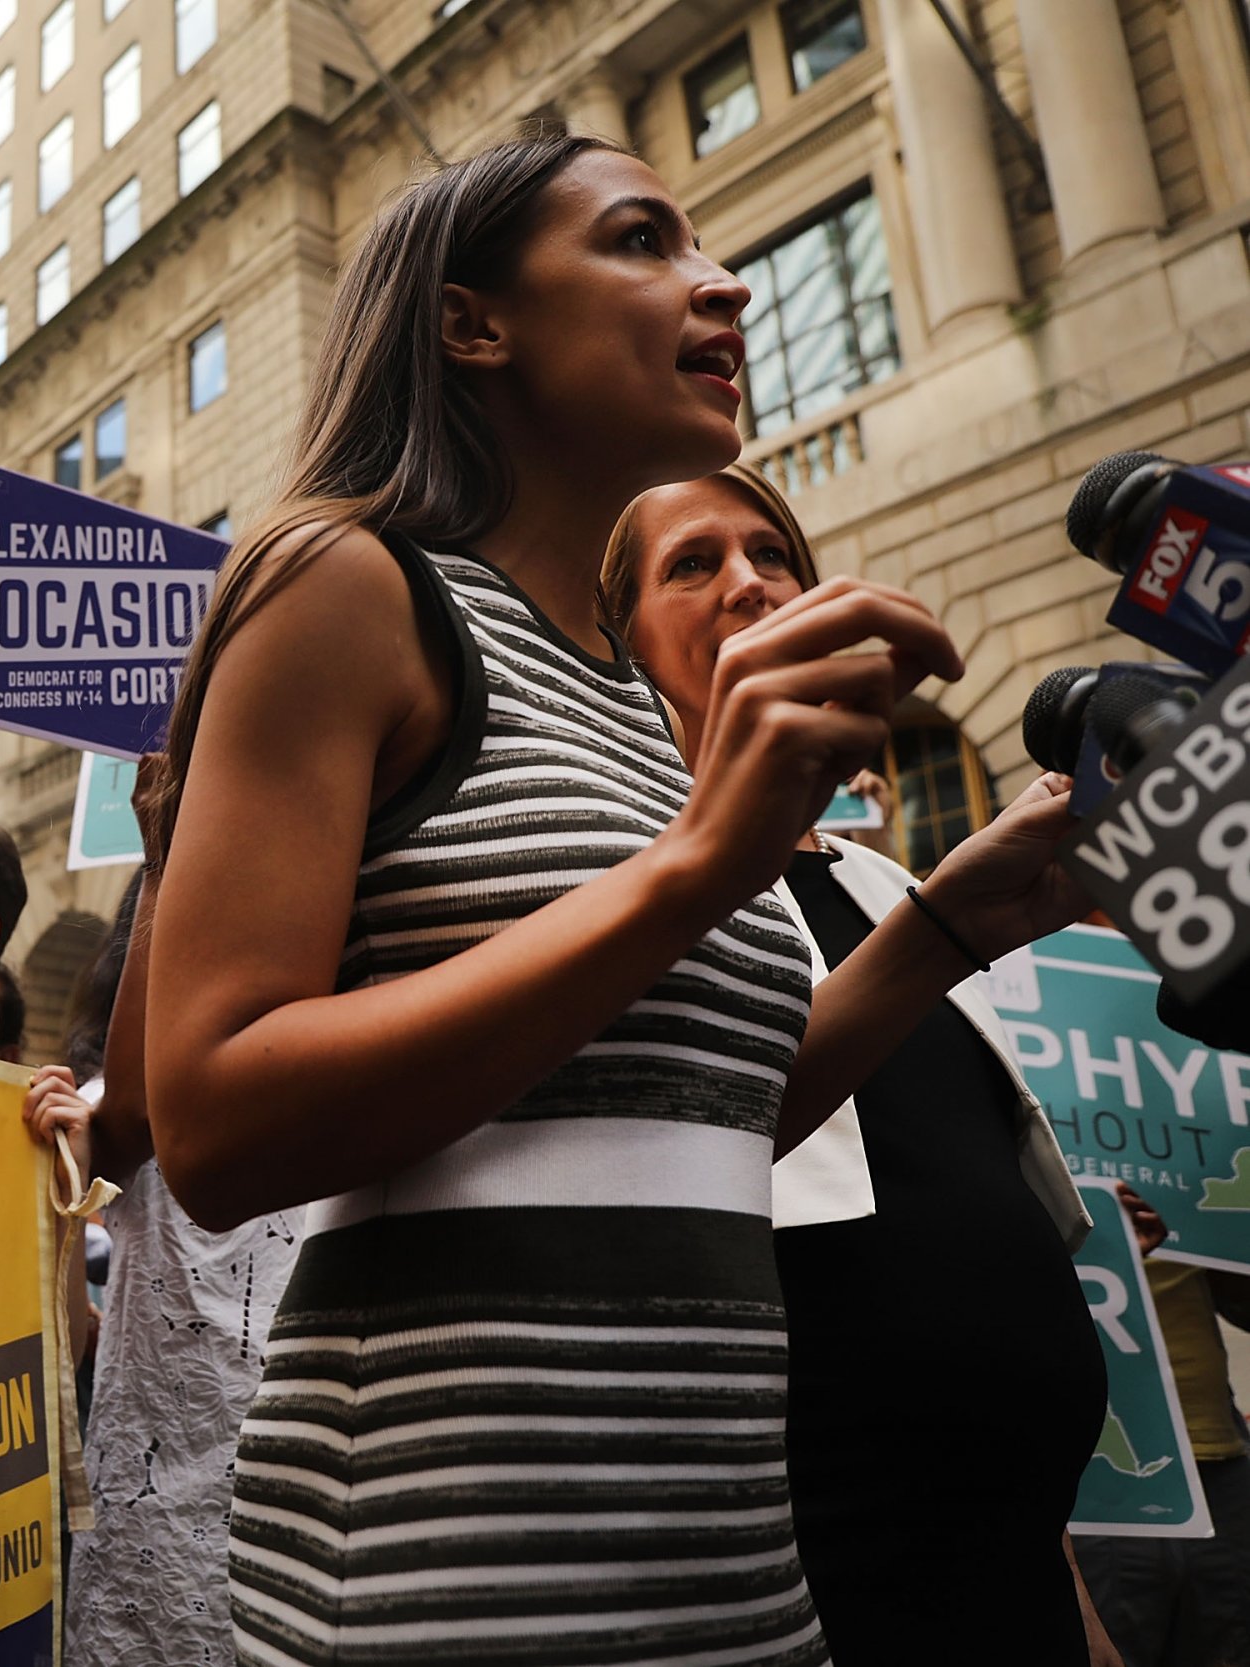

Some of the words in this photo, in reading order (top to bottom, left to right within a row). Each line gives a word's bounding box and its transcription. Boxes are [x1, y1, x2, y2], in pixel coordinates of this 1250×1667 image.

[1137, 516, 1198, 601] FOX
[1183, 545, 1250, 622] 5
[8, 670, 75, 687] DEMOCRAT
[79, 670, 103, 685] FOR
[66, 690, 103, 706] NY-14
[1066, 1153, 1190, 1191] GENERAL
